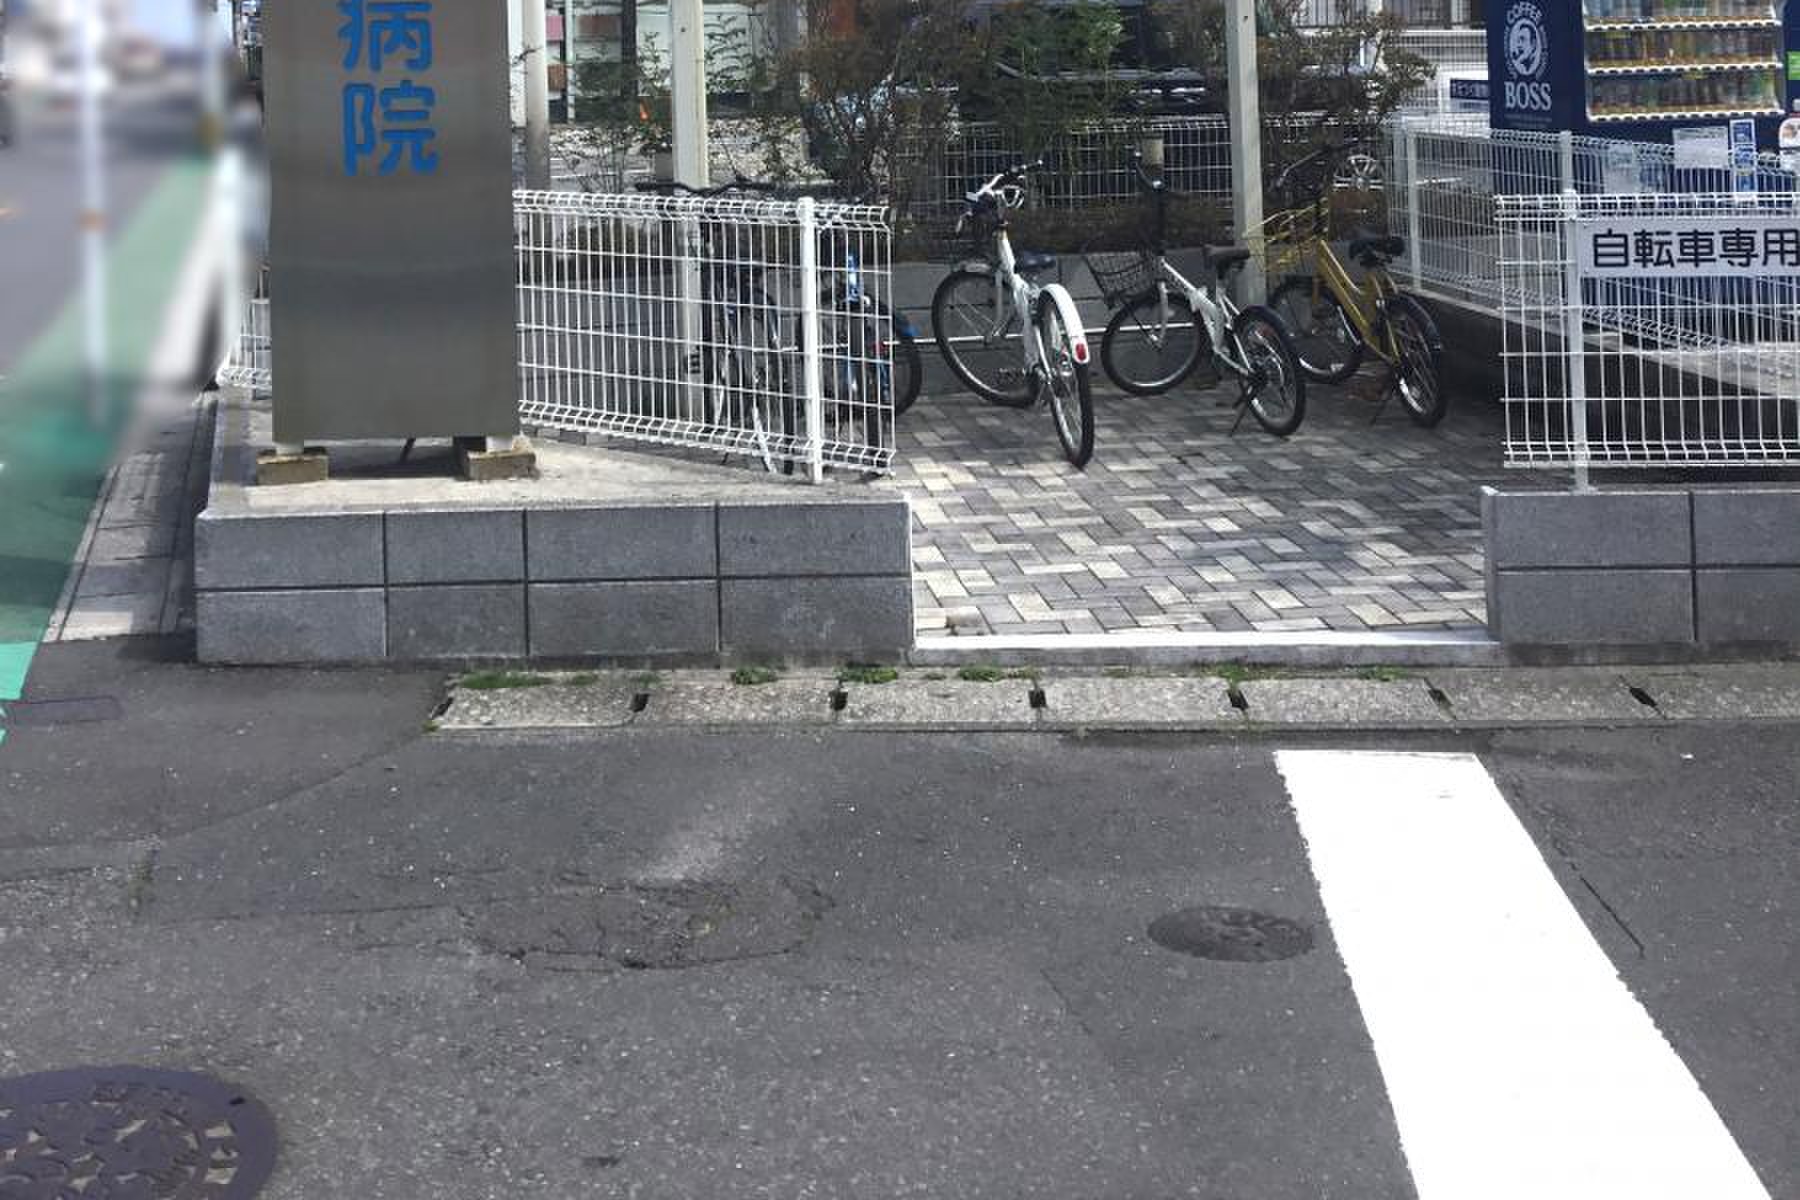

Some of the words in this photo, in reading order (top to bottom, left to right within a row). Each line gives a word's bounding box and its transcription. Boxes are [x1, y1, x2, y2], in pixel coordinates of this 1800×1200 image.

[1504, 81, 1552, 110] BOSS
[1593, 228, 1800, 268] 自転車専用
